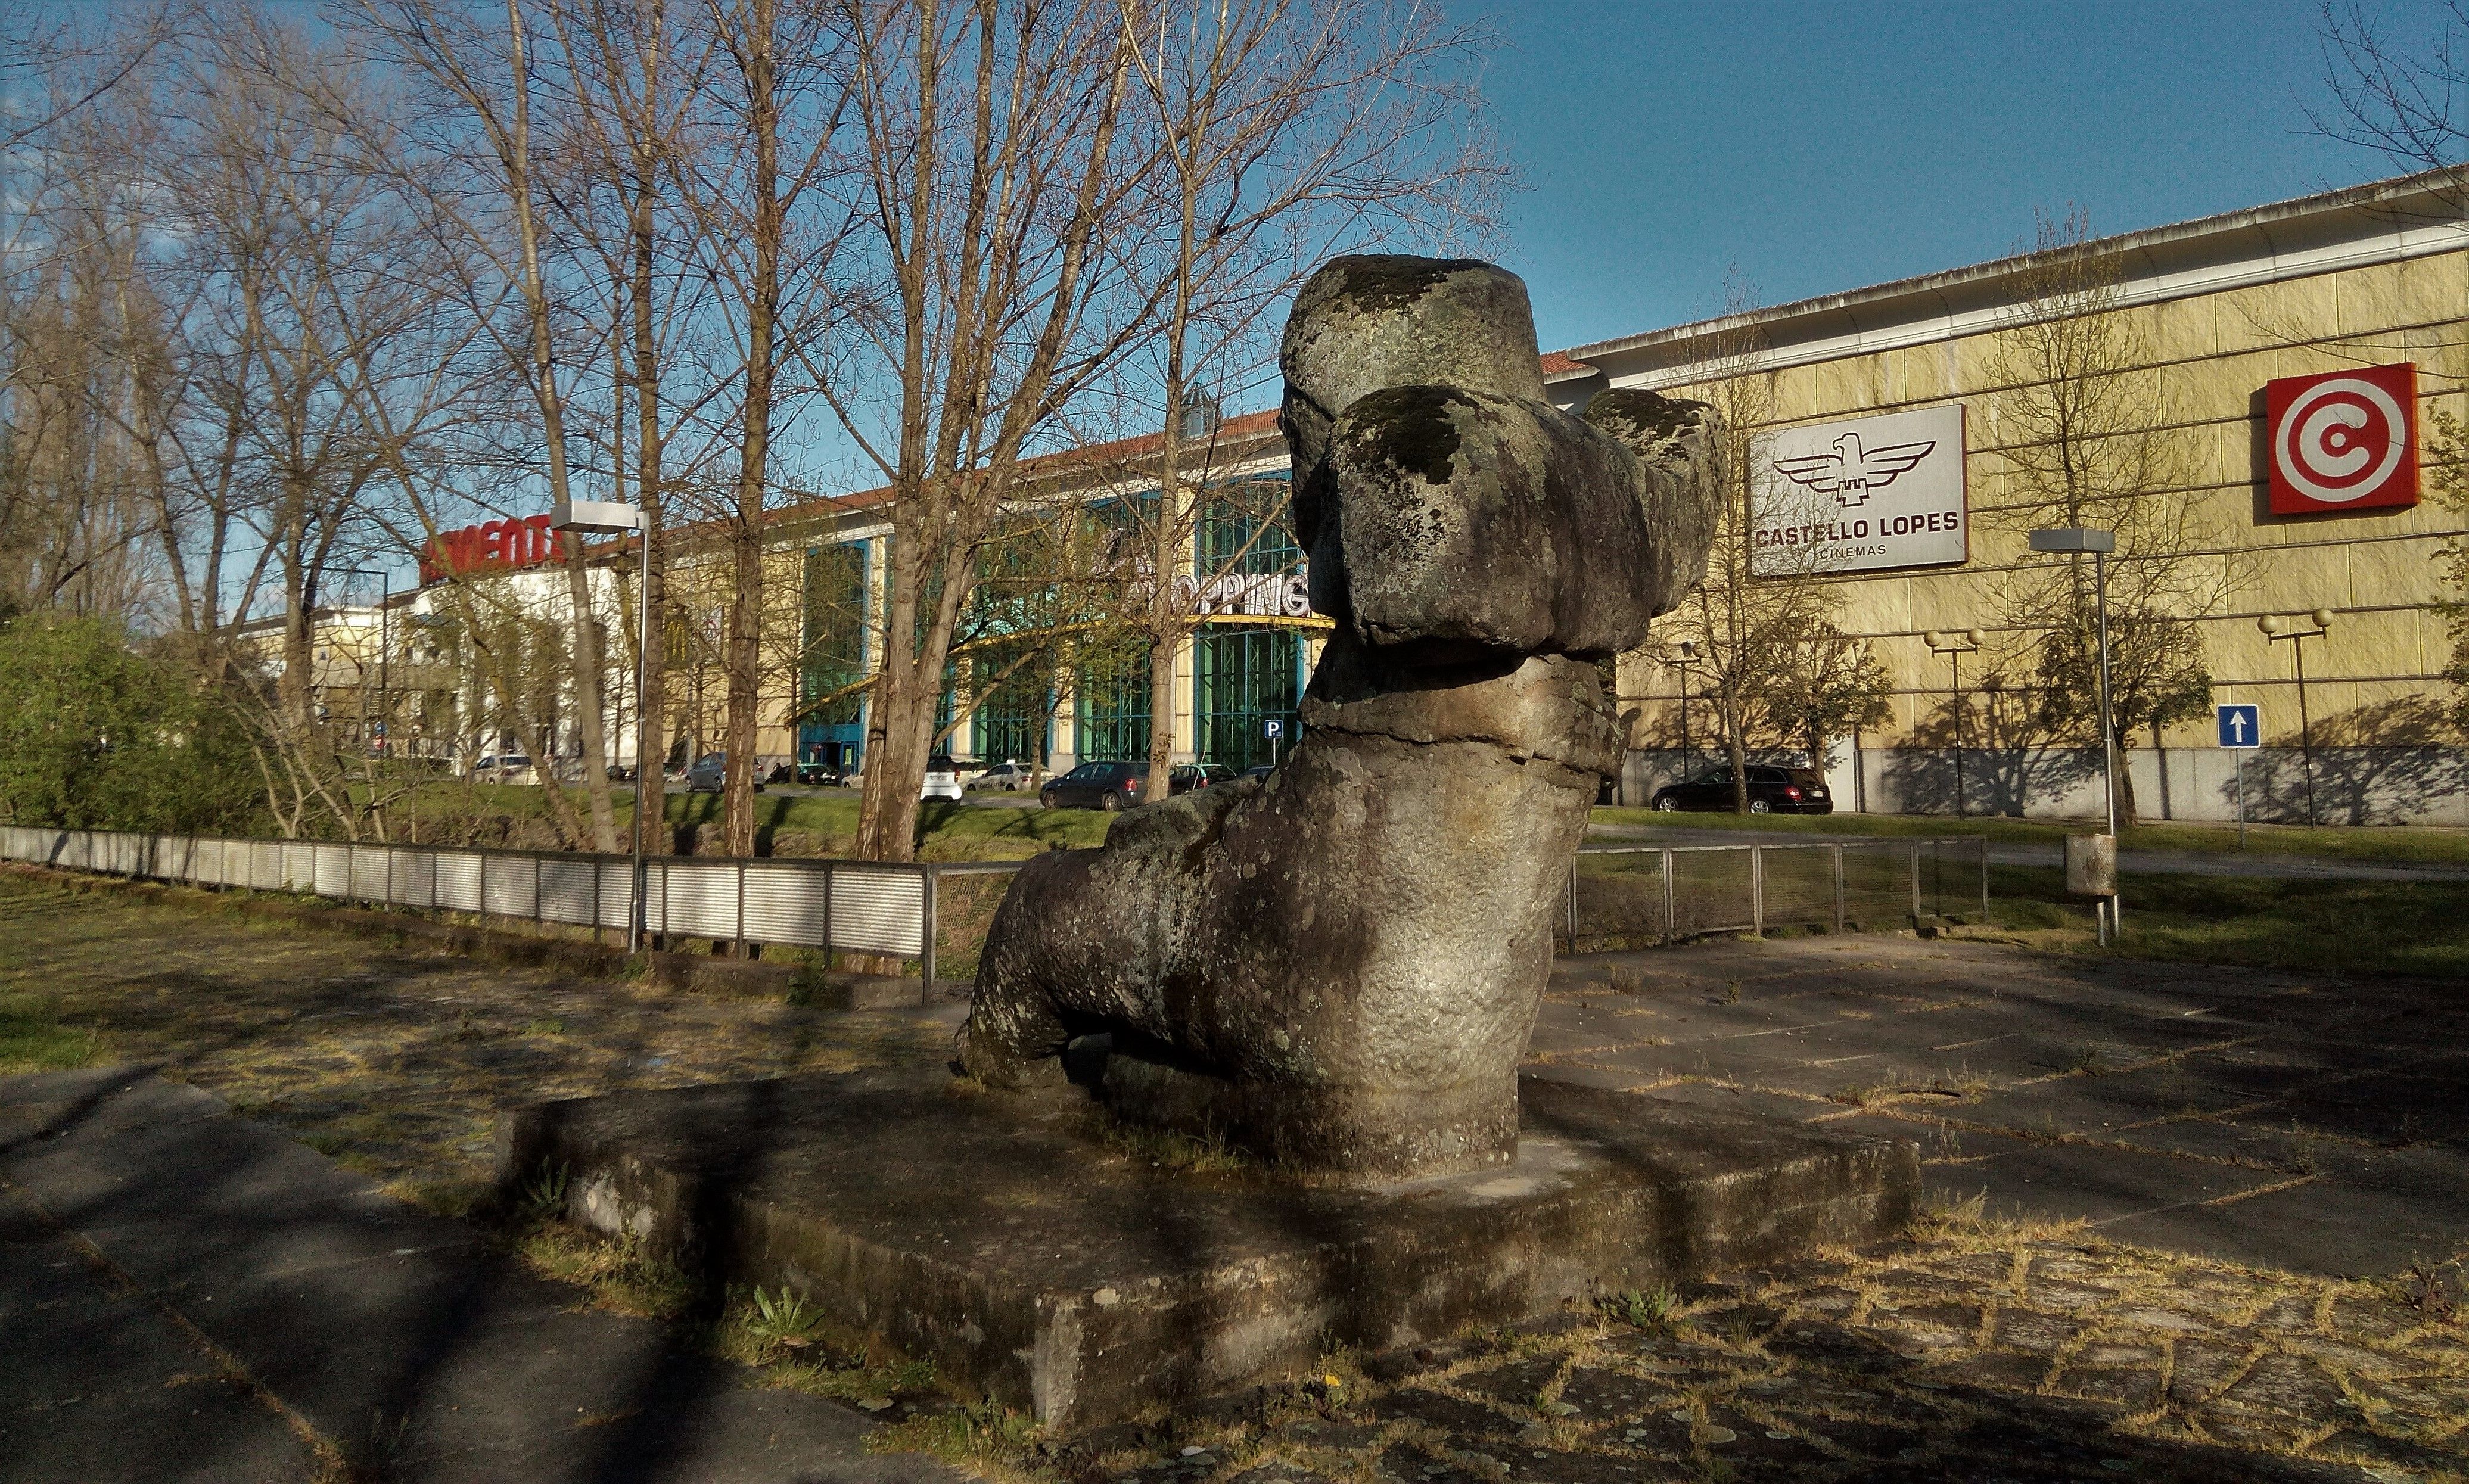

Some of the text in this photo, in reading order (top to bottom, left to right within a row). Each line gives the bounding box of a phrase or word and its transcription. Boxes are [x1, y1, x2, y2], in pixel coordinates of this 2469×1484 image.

[1756, 511, 1958, 547] CASTELLO LOPES
[1820, 545, 1887, 559] CINEMAS
[1268, 721, 1279, 737] P
